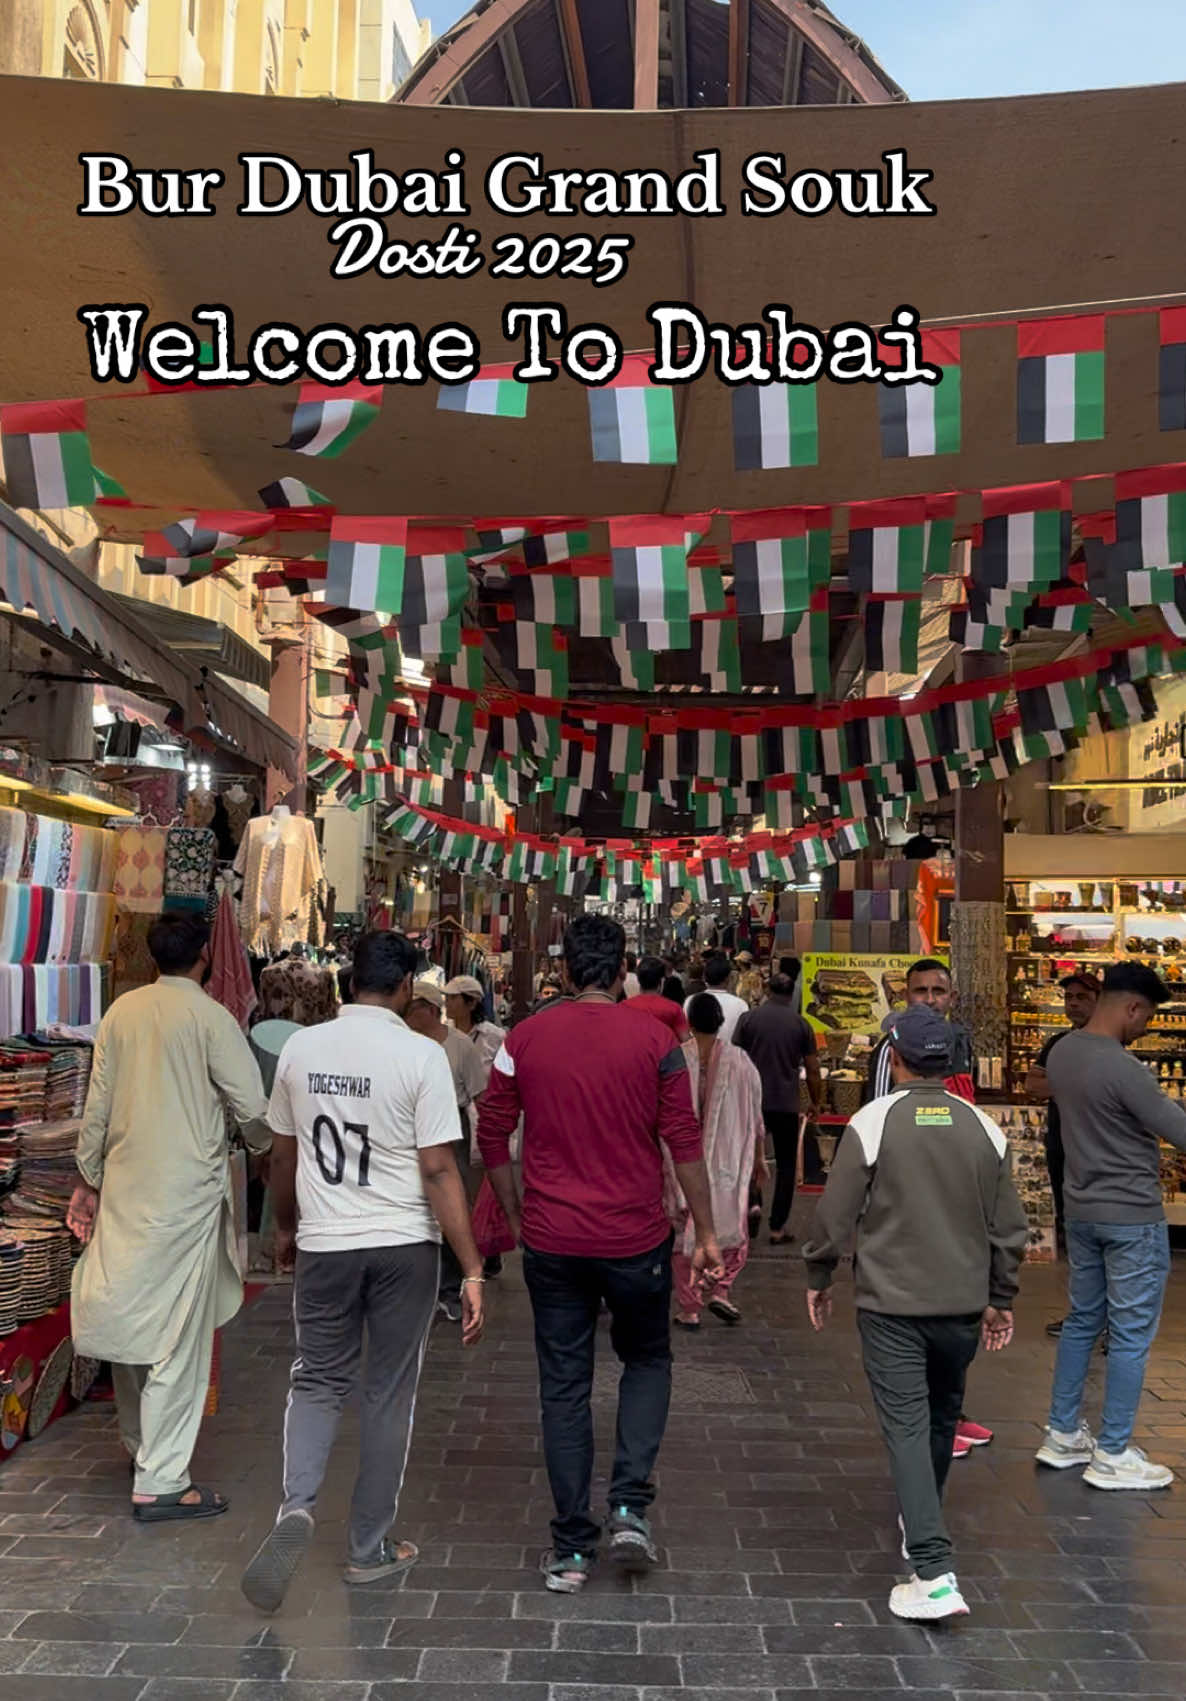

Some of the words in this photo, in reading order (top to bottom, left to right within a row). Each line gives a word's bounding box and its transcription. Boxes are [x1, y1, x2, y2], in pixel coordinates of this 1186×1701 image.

[815, 957, 846, 968] Dubai
[849, 957, 886, 969] Kunafa
[307, 1072, 371, 1099] YOGESHWAR
[915, 1106, 951, 1115] ZERO
[312, 1114, 372, 1187] 07
